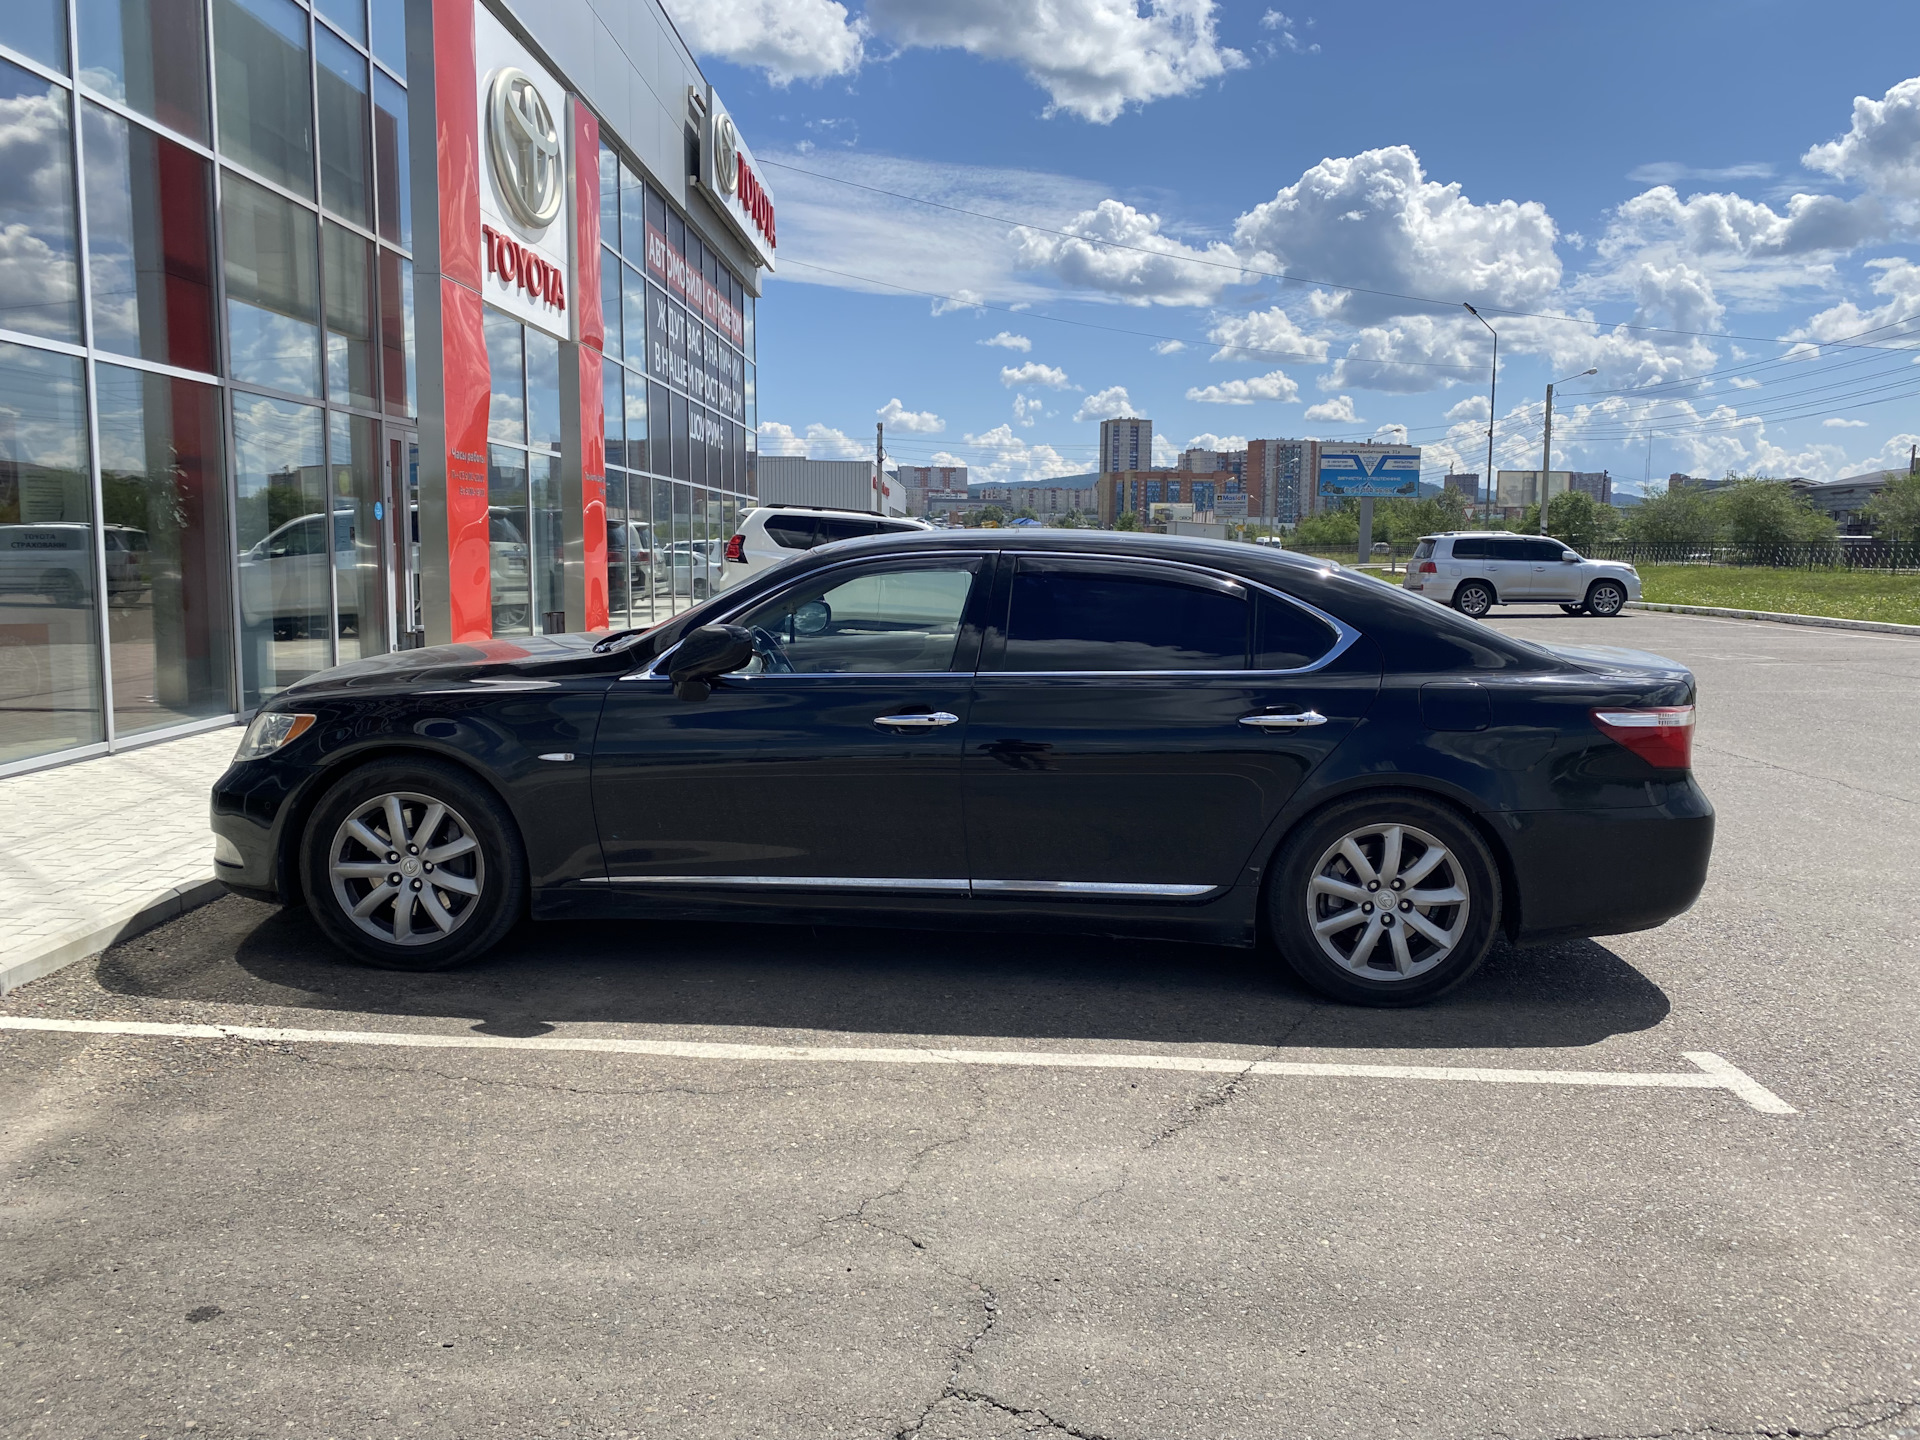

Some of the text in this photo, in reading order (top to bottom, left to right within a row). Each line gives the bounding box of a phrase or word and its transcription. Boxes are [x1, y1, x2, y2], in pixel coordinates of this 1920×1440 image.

[738, 151, 776, 248] TOYOTA
[482, 224, 565, 310] TOYOTA
[649, 232, 705, 308] АВТОМОБИЛИ
[706, 288, 712, 314] С
[656, 298, 685, 345] ЖДУТ
[687, 321, 702, 357] ВАС
[704, 335, 708, 361] В
[654, 341, 742, 417] В НАШЕМ ПРОСТОРНОМ
